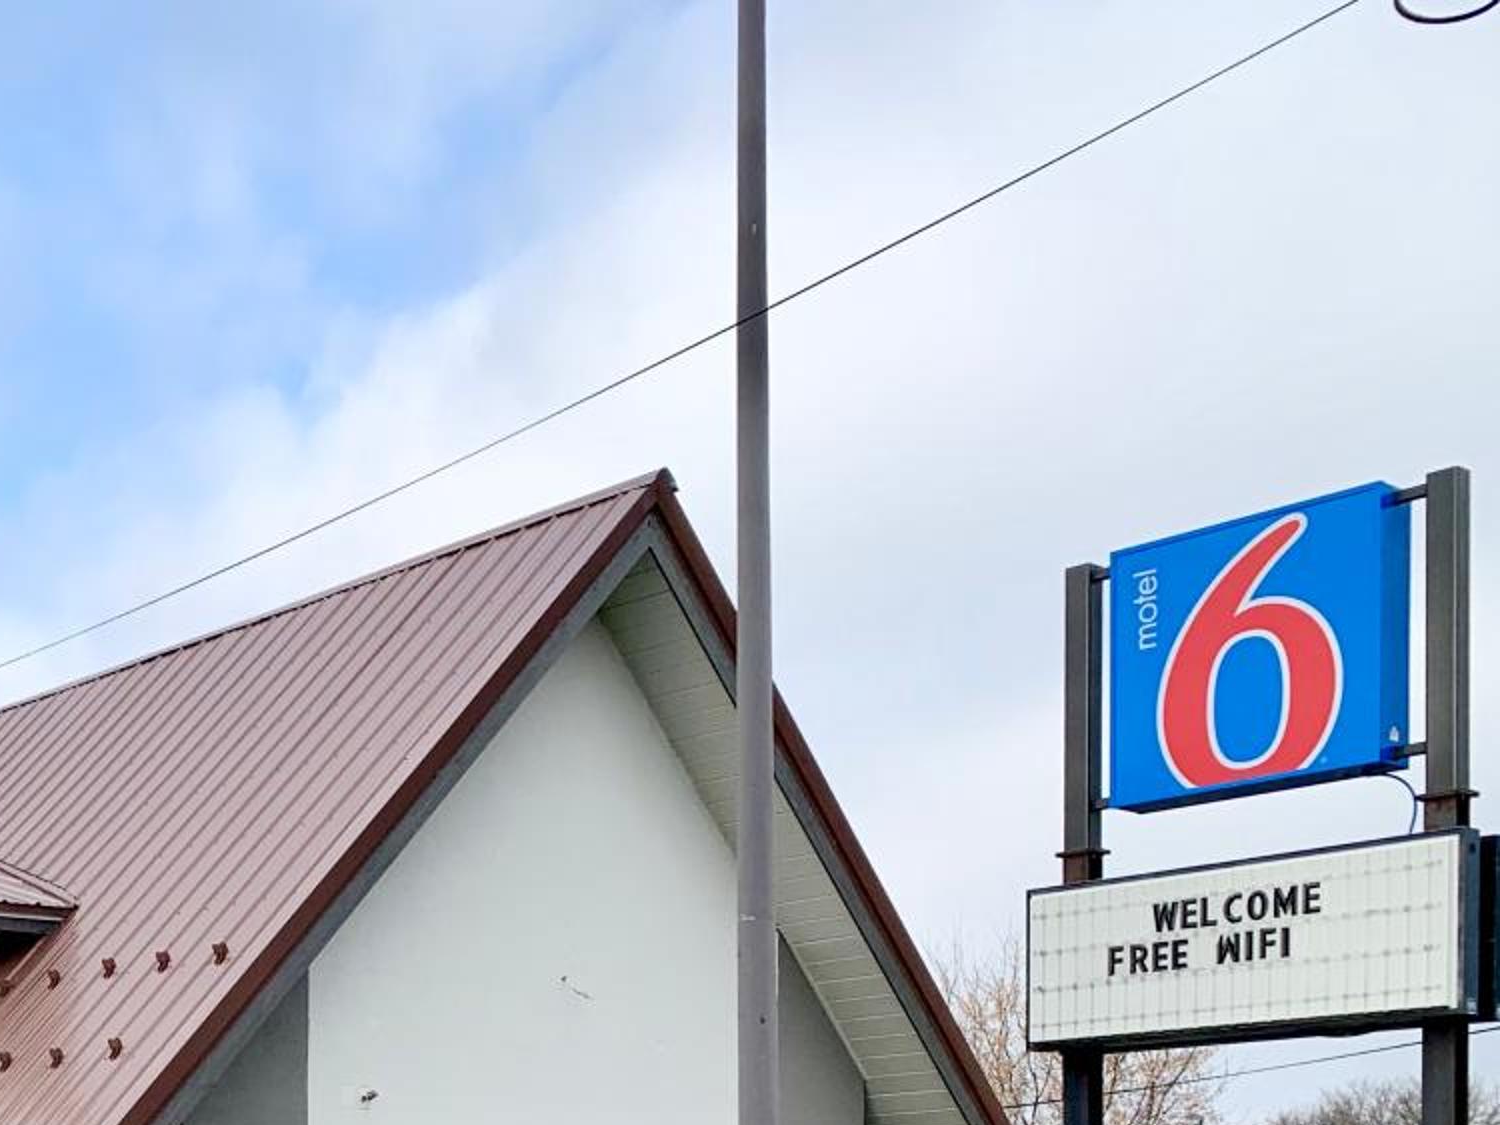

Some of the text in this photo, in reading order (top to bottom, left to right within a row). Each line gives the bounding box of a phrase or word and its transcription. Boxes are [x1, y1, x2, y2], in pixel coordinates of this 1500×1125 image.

[1132, 511, 1344, 789] motel 6
[1152, 881, 1322, 933] WELCOME
[1107, 926, 1292, 977] FREE WIFI
